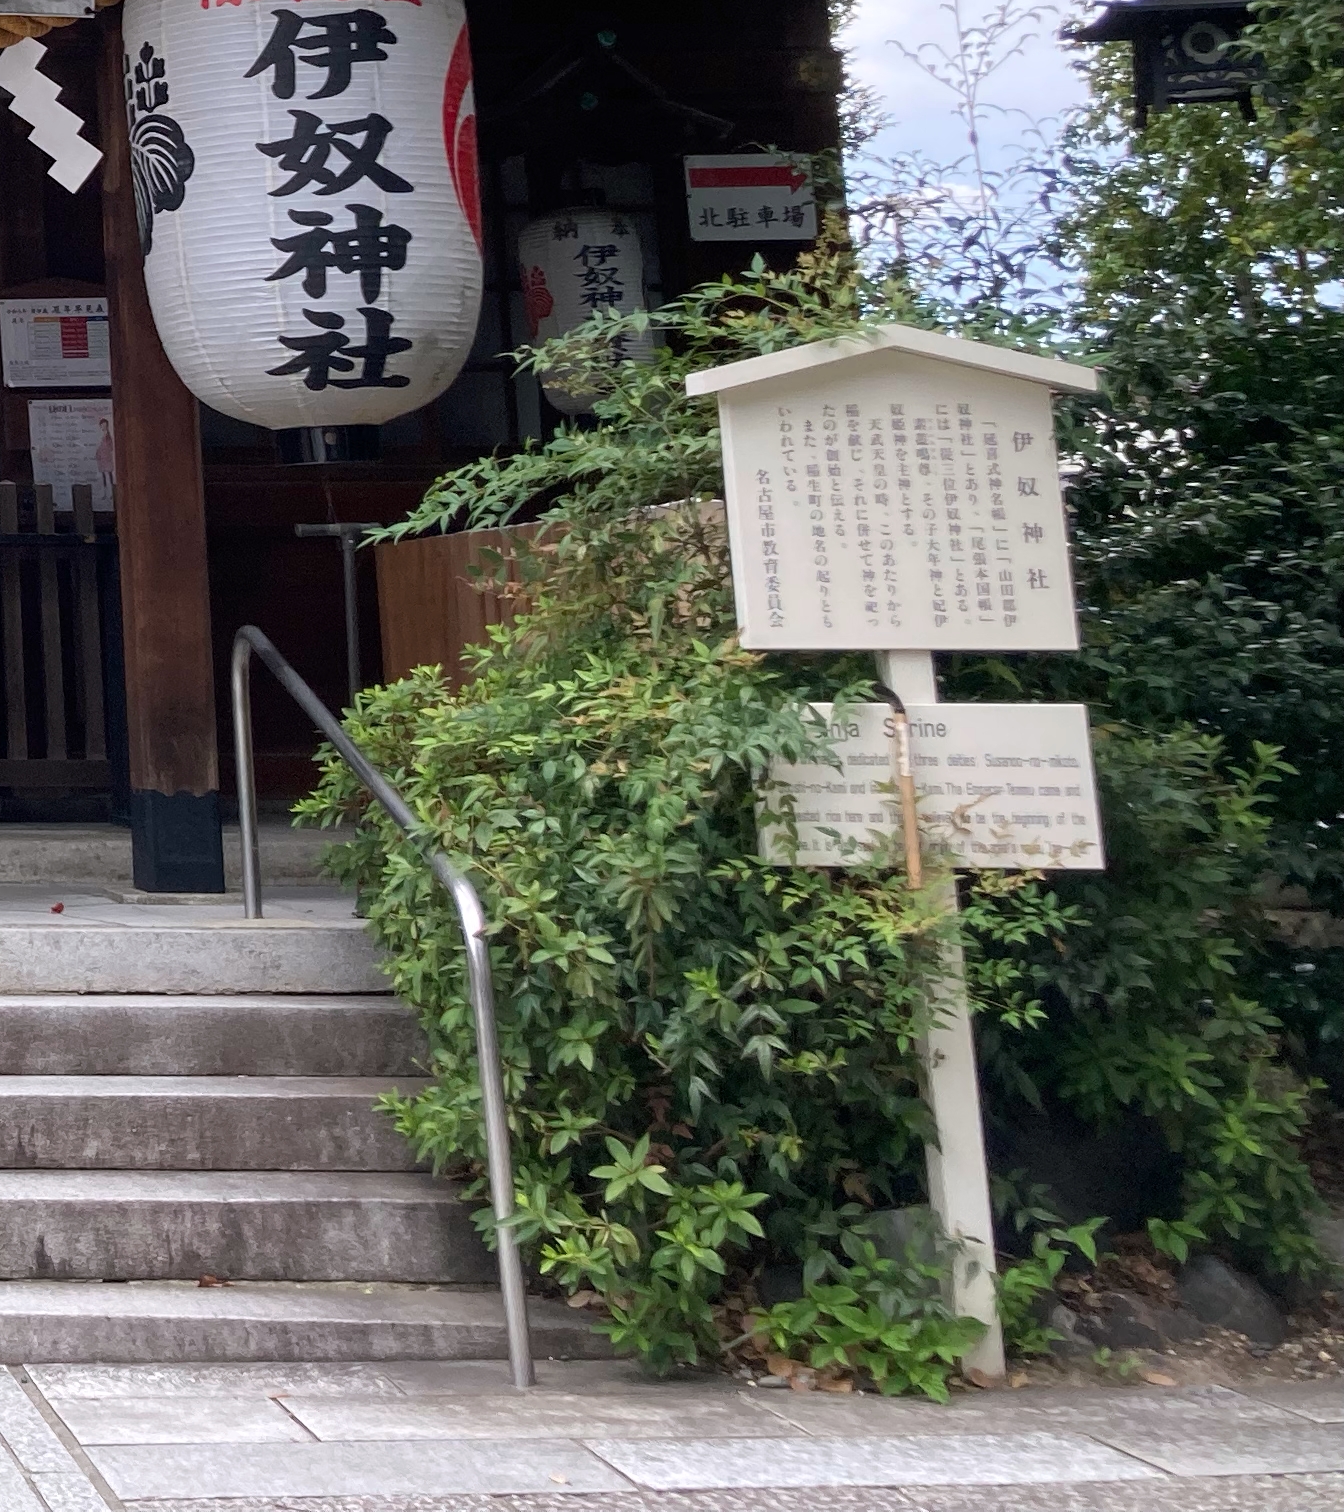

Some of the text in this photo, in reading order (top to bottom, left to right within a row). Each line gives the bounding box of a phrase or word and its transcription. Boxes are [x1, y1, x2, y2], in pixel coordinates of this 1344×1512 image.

[243, 8, 415, 392] 伊奴神社
[698, 204, 805, 228] 北駐車場
[778, 406, 800, 506] いわれている。
[1012, 430, 1050, 592] 伊奴神社
[755, 469, 785, 629] 名古屋市教育委員会
[883, 717, 948, 738] Srine
